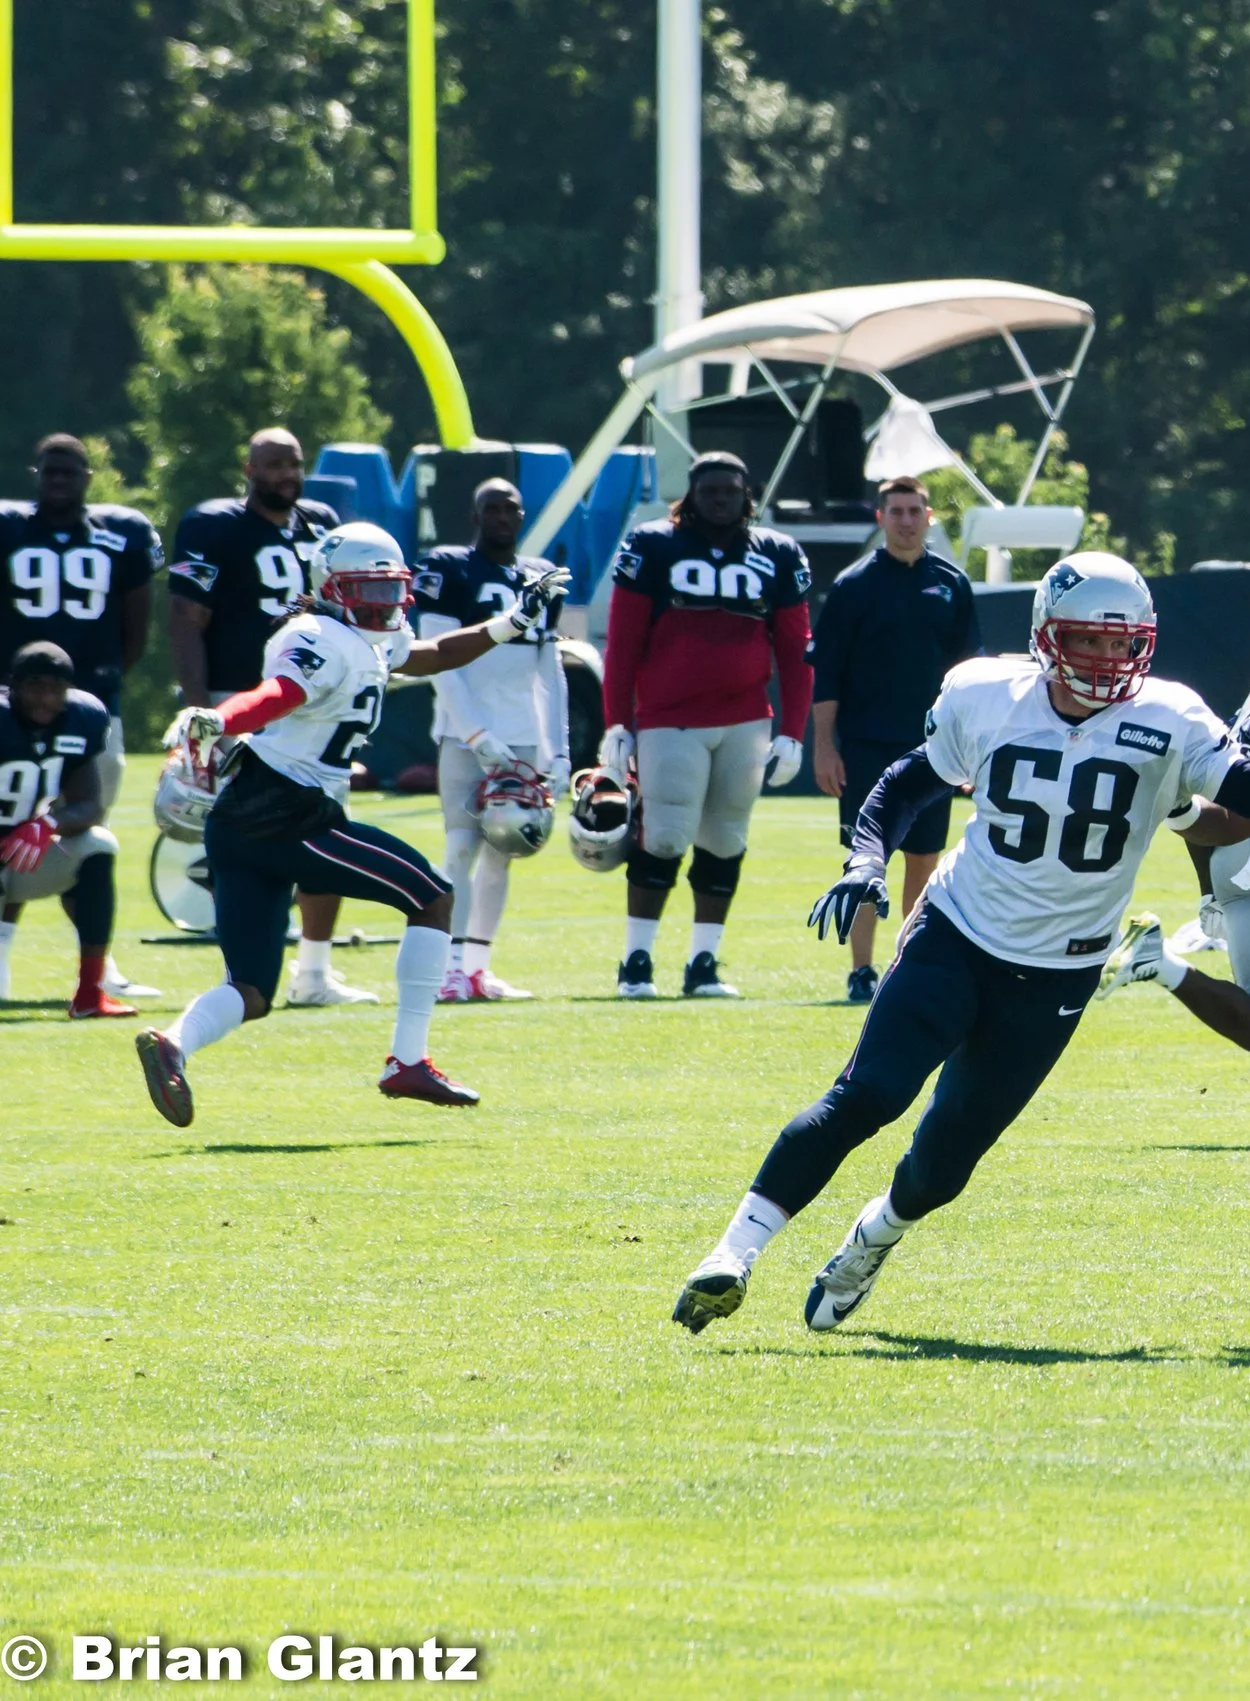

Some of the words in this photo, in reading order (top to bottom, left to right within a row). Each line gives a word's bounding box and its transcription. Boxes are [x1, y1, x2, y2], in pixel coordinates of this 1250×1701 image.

[11, 547, 112, 620] 99
[1119, 728, 1166, 750] Gillette
[0, 755, 65, 826] 91
[986, 743, 1140, 873] 58
